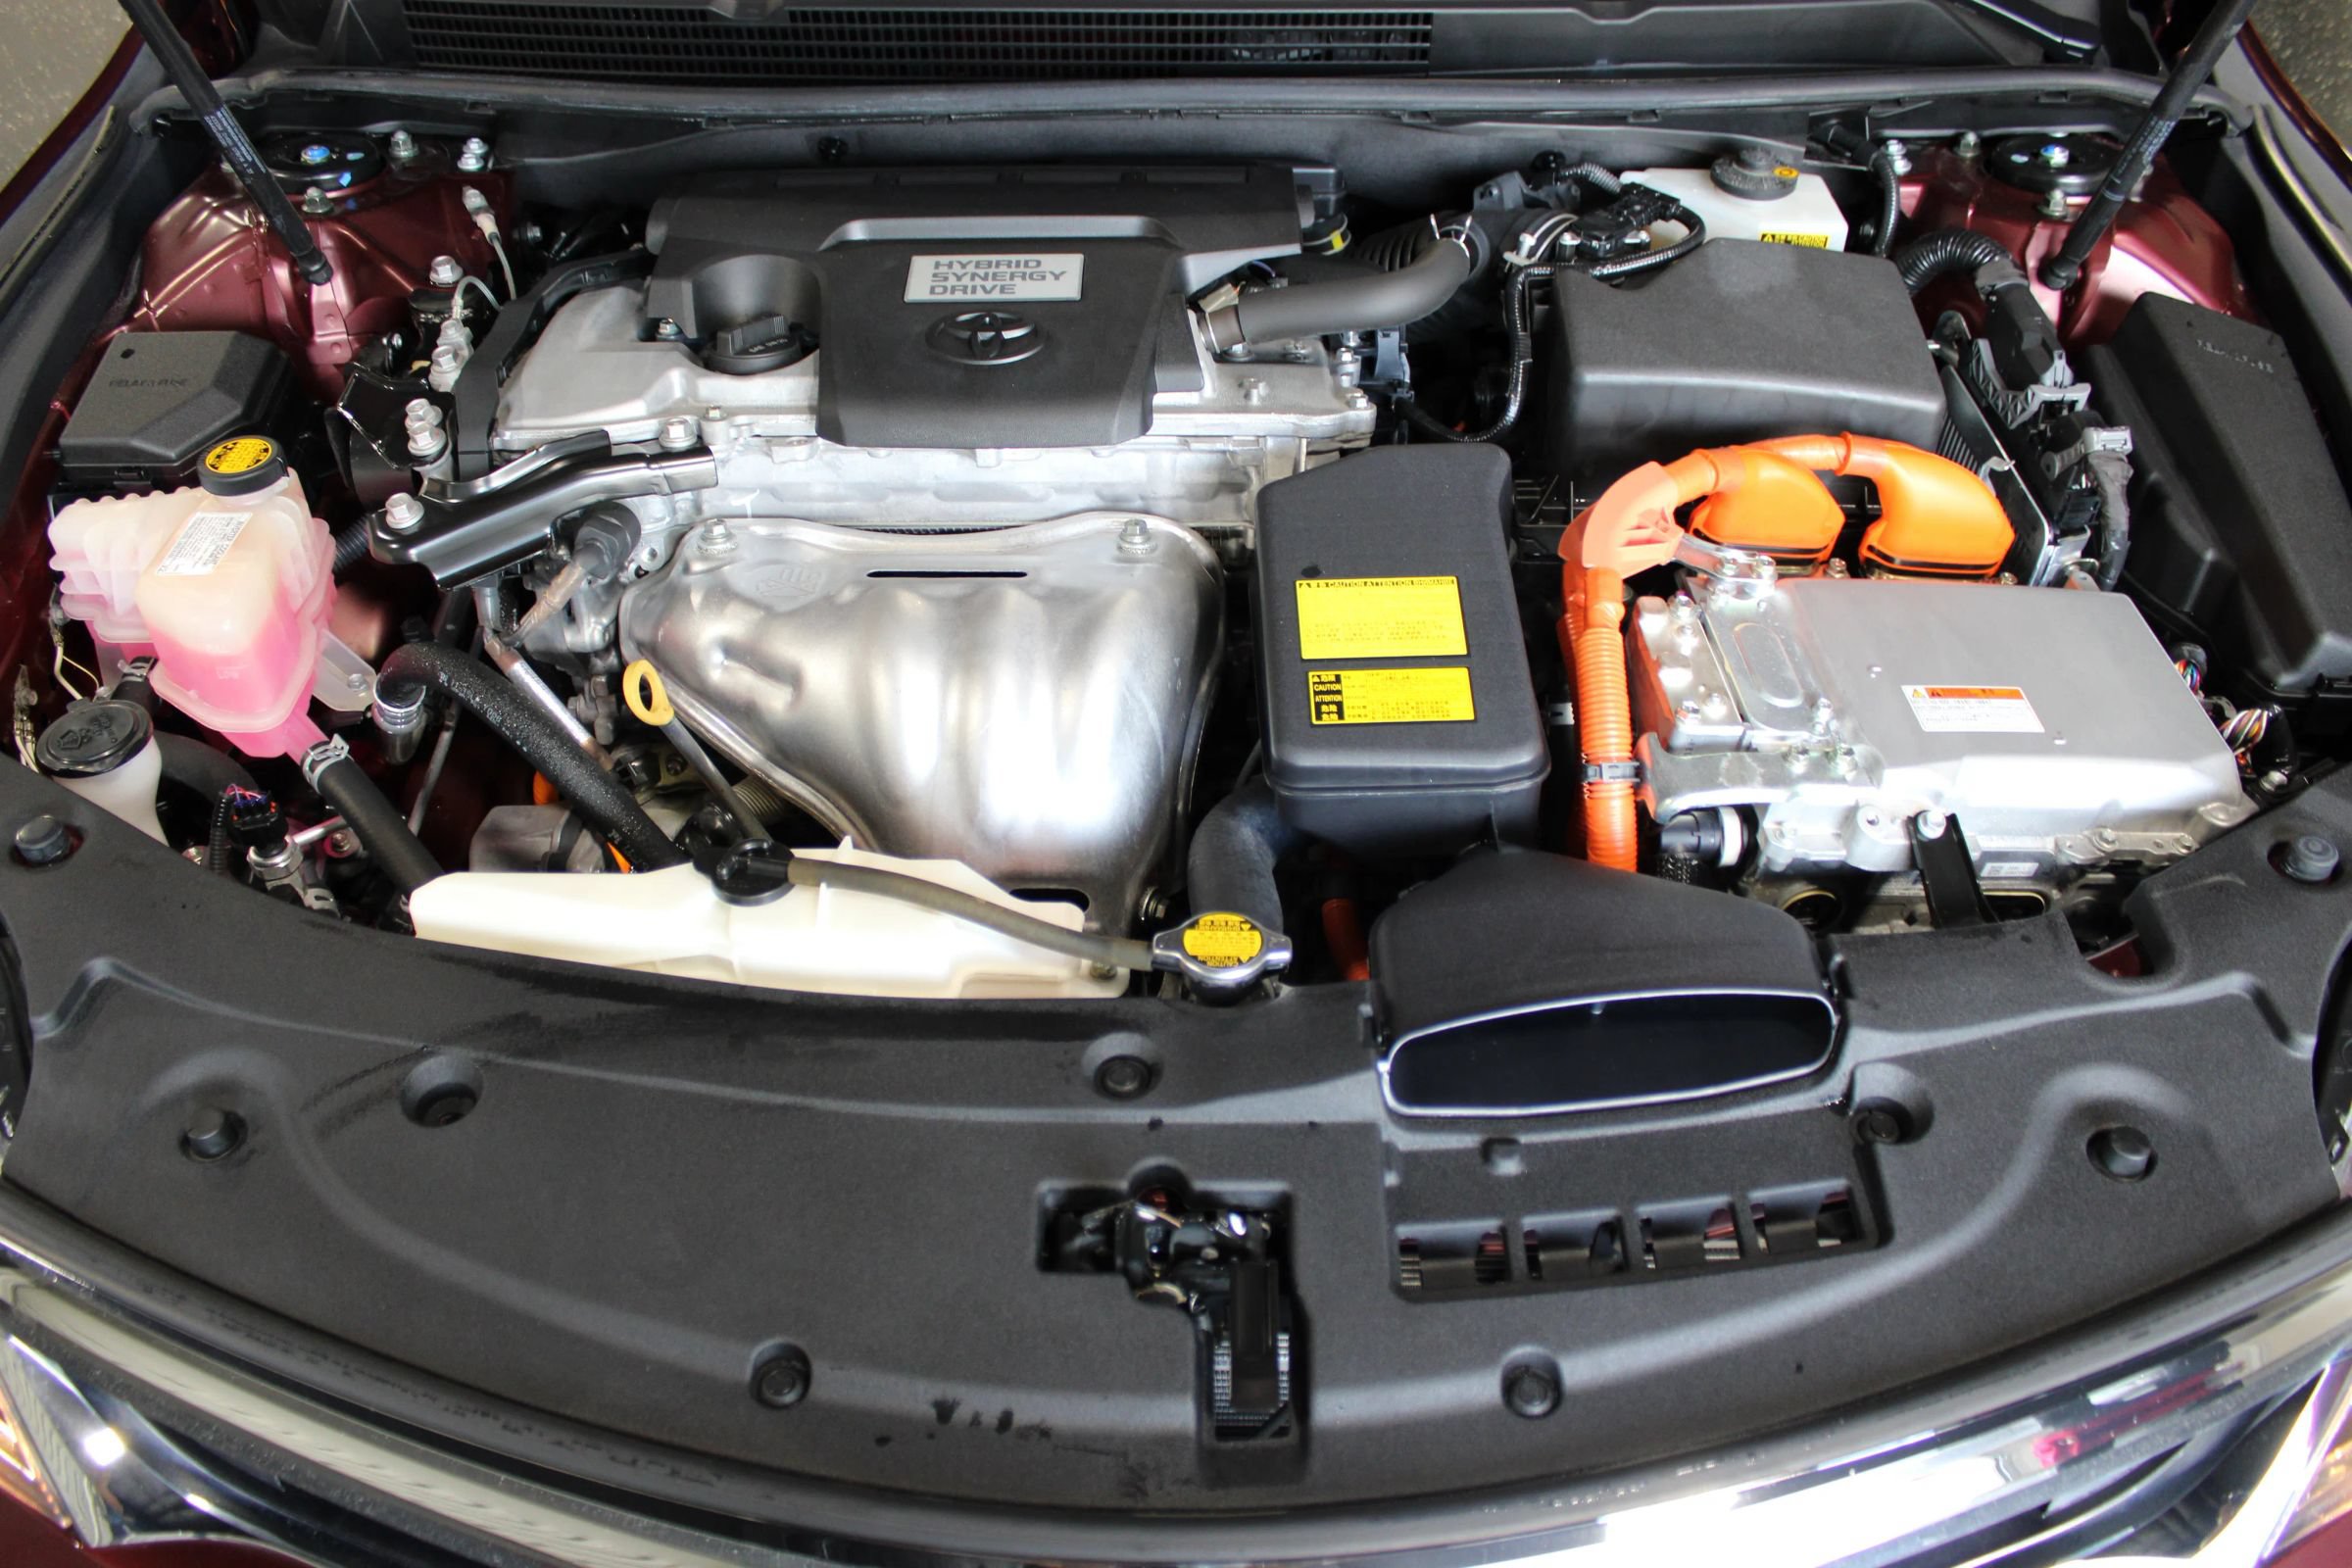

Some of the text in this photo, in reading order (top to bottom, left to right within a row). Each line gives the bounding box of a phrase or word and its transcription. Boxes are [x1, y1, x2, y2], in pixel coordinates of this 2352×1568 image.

[934, 259, 1042, 270] HYBRID
[931, 270, 1067, 282] SYNERGY
[929, 283, 1017, 296] DRIVE
[1313, 683, 1342, 692] CAUTION
[1314, 694, 1343, 703] ATTENTION
